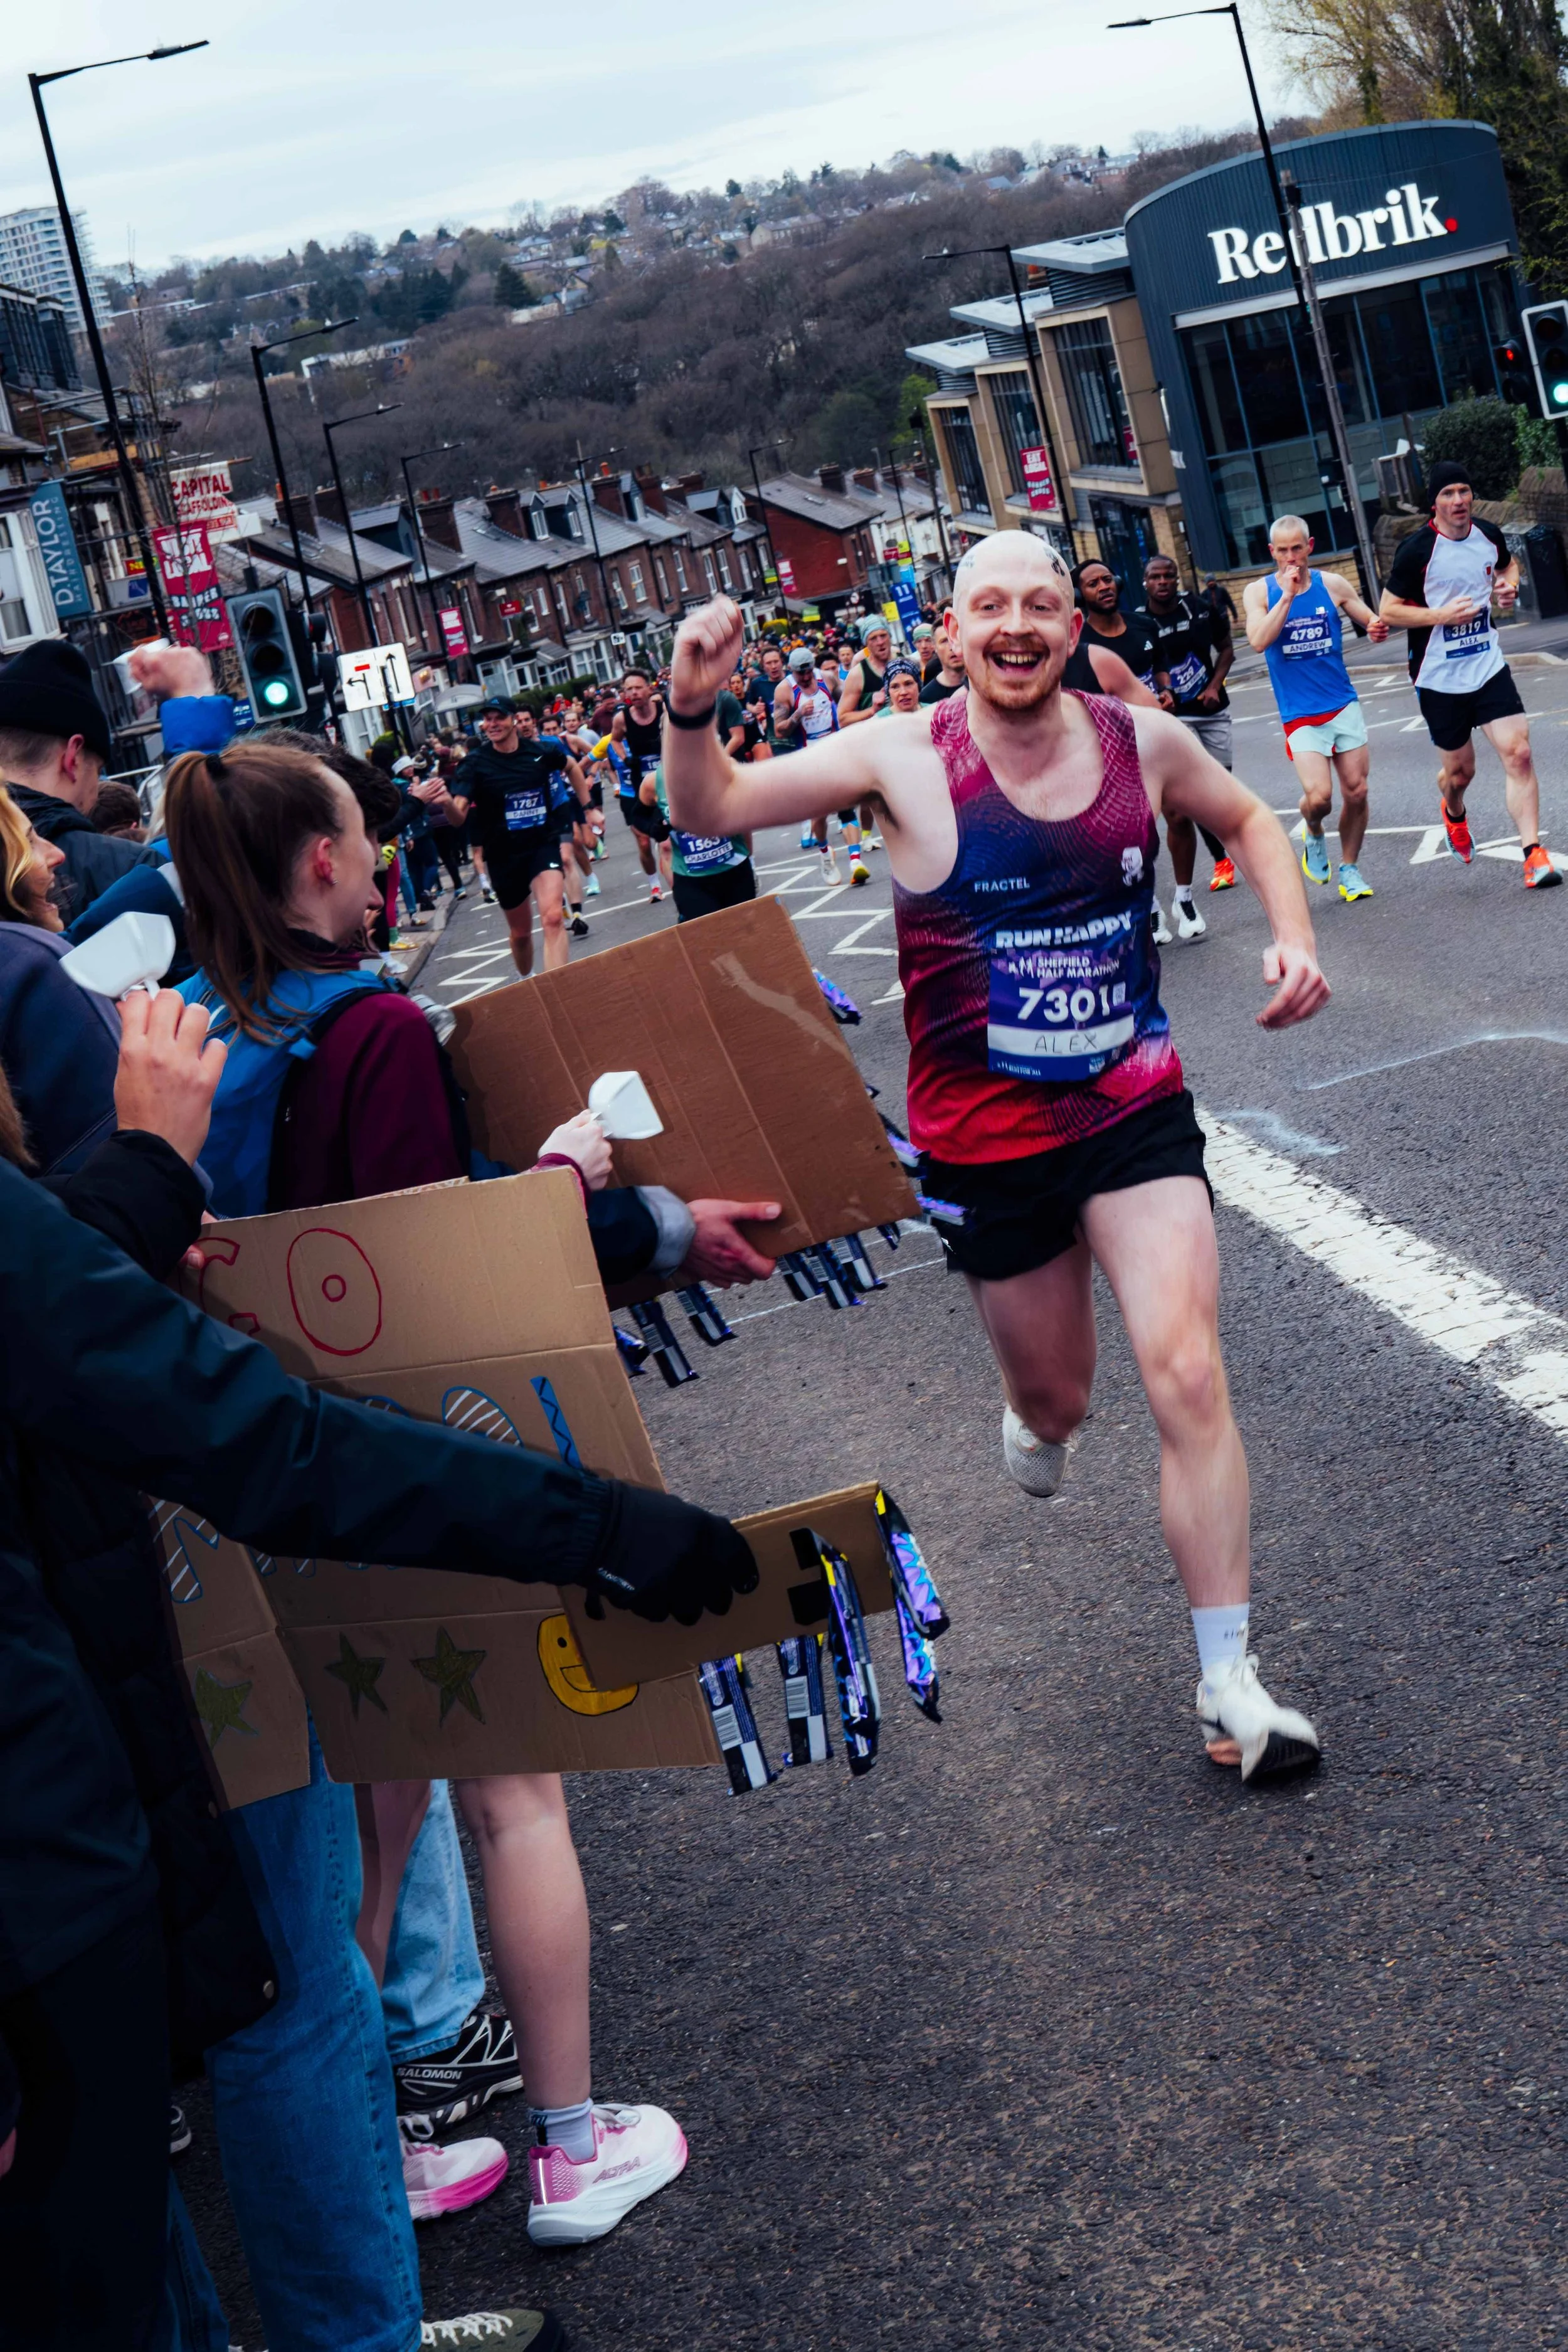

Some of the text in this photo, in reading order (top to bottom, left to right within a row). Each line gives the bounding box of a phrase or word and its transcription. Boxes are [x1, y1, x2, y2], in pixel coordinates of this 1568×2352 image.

[171, 474, 230, 501] CAPITAL
[32, 499, 75, 606] D.TAYLOR
[1290, 626, 1323, 641] 4789
[1451, 620, 1481, 638] 3819
[1290, 640, 1326, 652] ANDREW
[1459, 637, 1478, 647] ALEX
[513, 797, 539, 810] 1787
[974, 876, 1030, 893] FRACTEL
[995, 910, 1131, 949] RUN HAPPY
[1037, 955, 1090, 968] SHEFFIELD
[1037, 959, 1120, 978] HALF MARATHON
[1017, 983, 1110, 1023] 7301
[1034, 1031, 1098, 1054] ALEX
[396, 2067, 463, 2080] SALOMON
[591, 2156, 641, 2184] ALTRA
